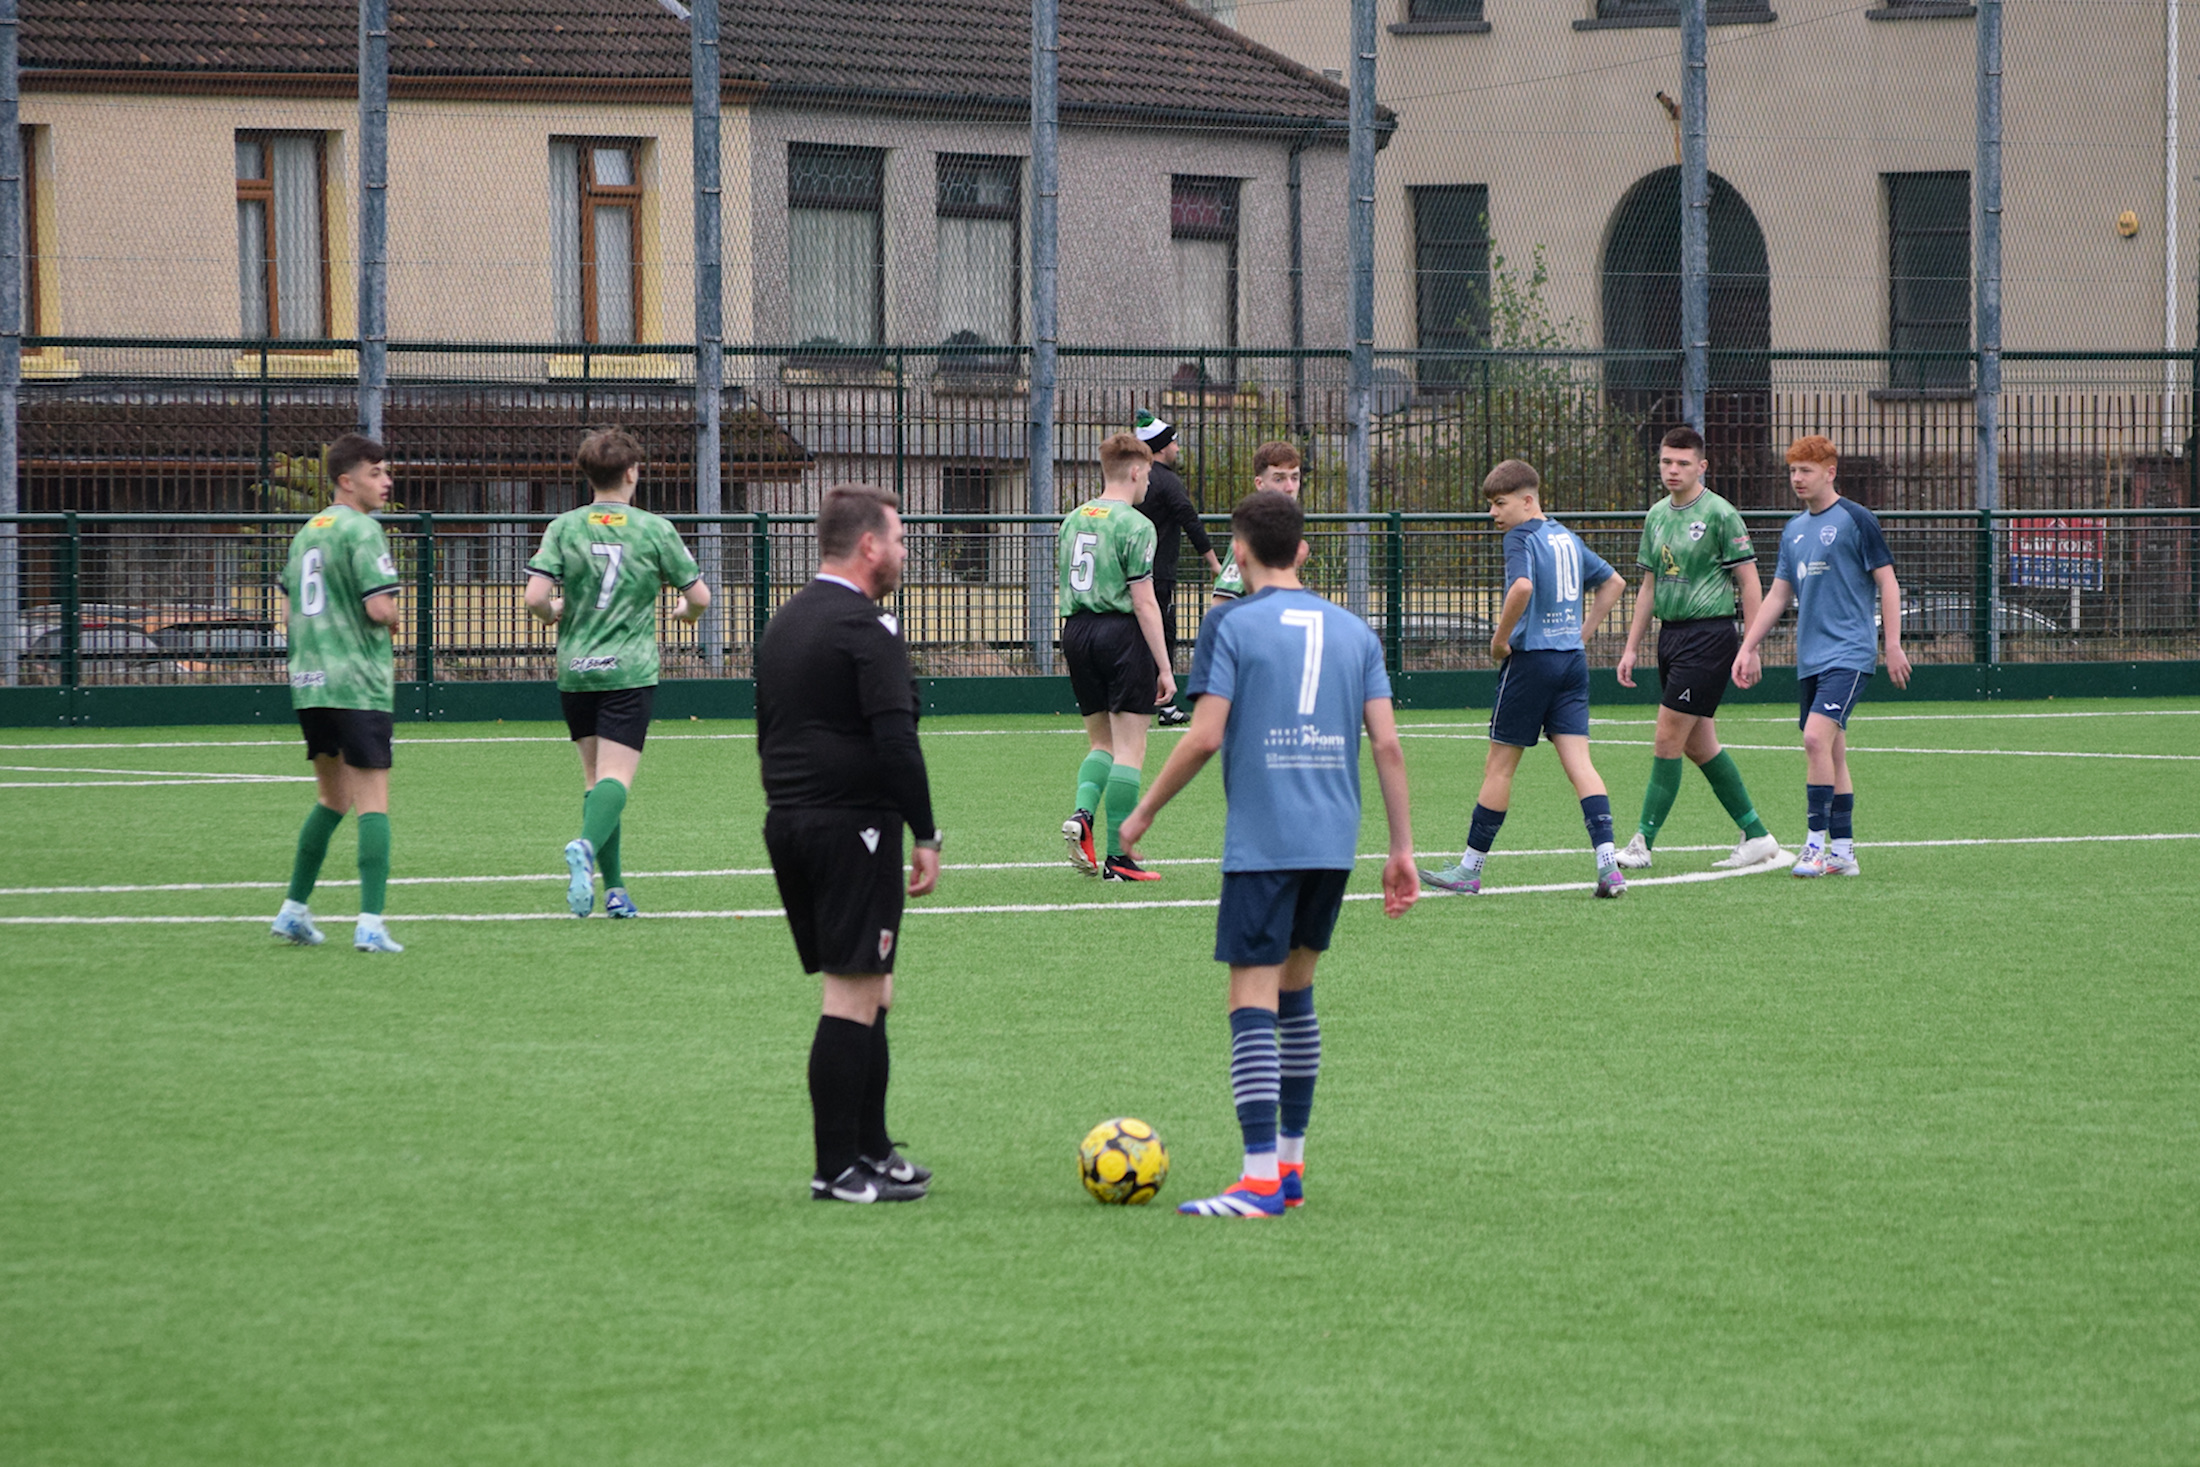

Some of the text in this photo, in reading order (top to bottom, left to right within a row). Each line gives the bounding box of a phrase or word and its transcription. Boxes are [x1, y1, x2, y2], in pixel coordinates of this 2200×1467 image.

[300, 546, 325, 617] 6
[591, 542, 623, 610] 7
[1070, 532, 1098, 592] 5
[1547, 532, 1580, 603] 10
[1280, 609, 1323, 715] 7
[1264, 737, 1298, 746] LEVEL
